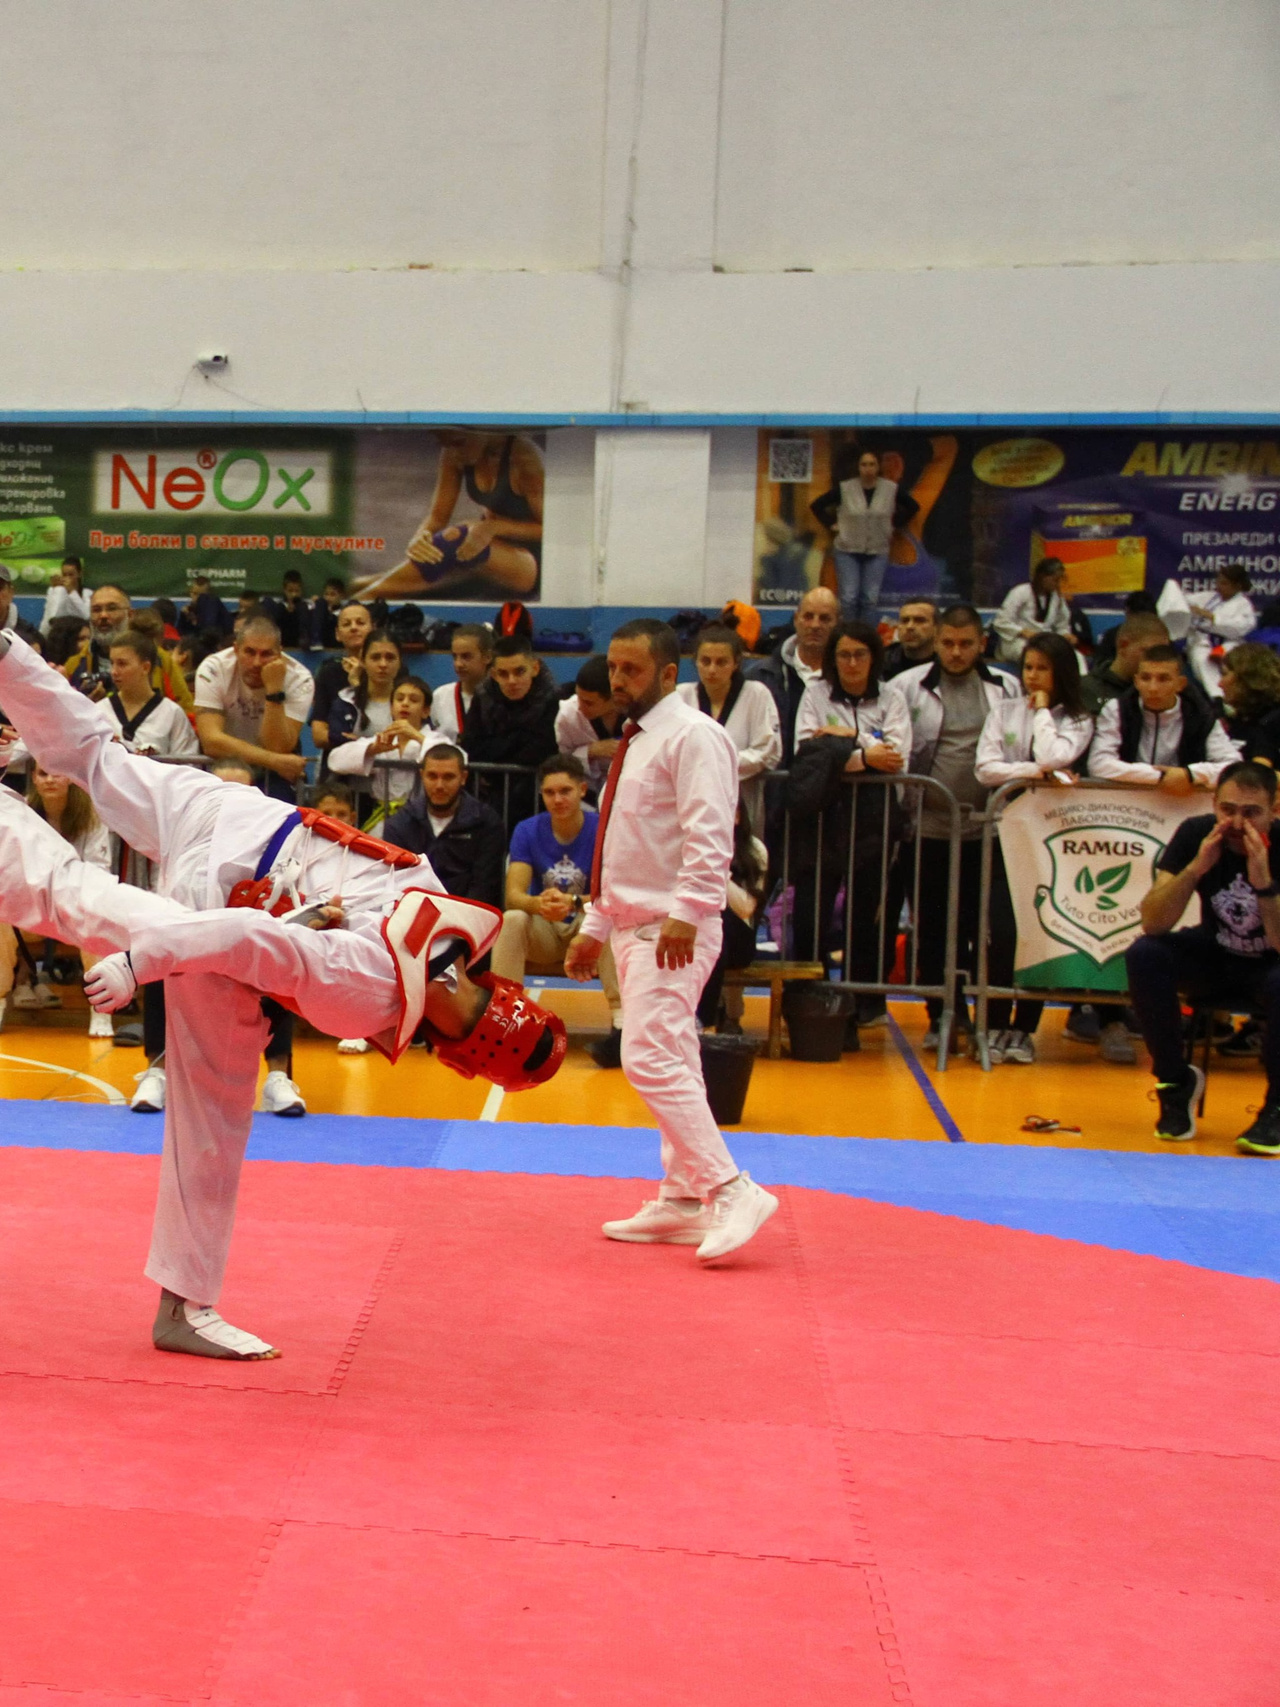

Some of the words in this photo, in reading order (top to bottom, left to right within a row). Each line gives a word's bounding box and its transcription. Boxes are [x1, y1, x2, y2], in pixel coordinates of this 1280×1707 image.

[89, 530, 124, 552] При
[128, 530, 182, 549] болки
[187, 535, 196, 549] в
[201, 535, 269, 550] ставите
[275, 535, 285, 549] и
[291, 535, 385, 554] мускулите
[1062, 840, 1145, 857] RAMUS
[1088, 911, 1117, 924] Cito
